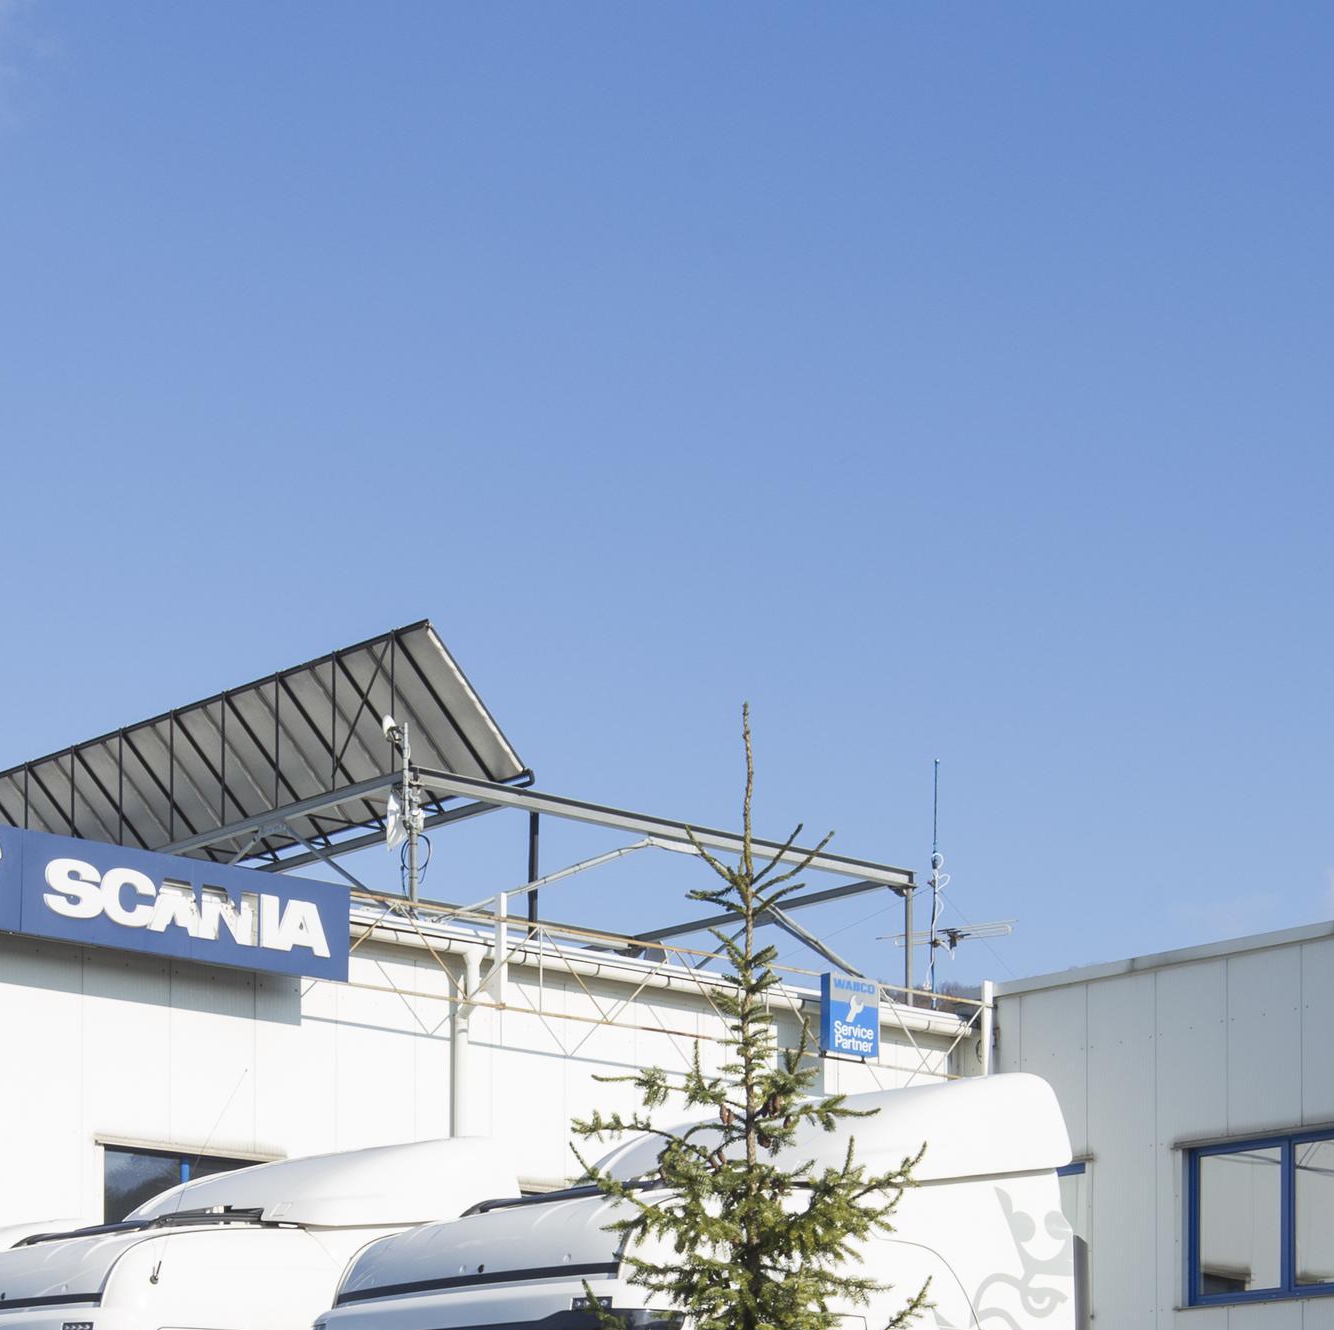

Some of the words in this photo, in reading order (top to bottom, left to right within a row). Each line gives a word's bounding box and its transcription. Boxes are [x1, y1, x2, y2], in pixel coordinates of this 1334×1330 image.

[43, 858, 330, 958] SCANIA
[833, 977, 876, 995] WABCO
[834, 1020, 874, 1040] Service
[835, 1034, 873, 1053] Partner
